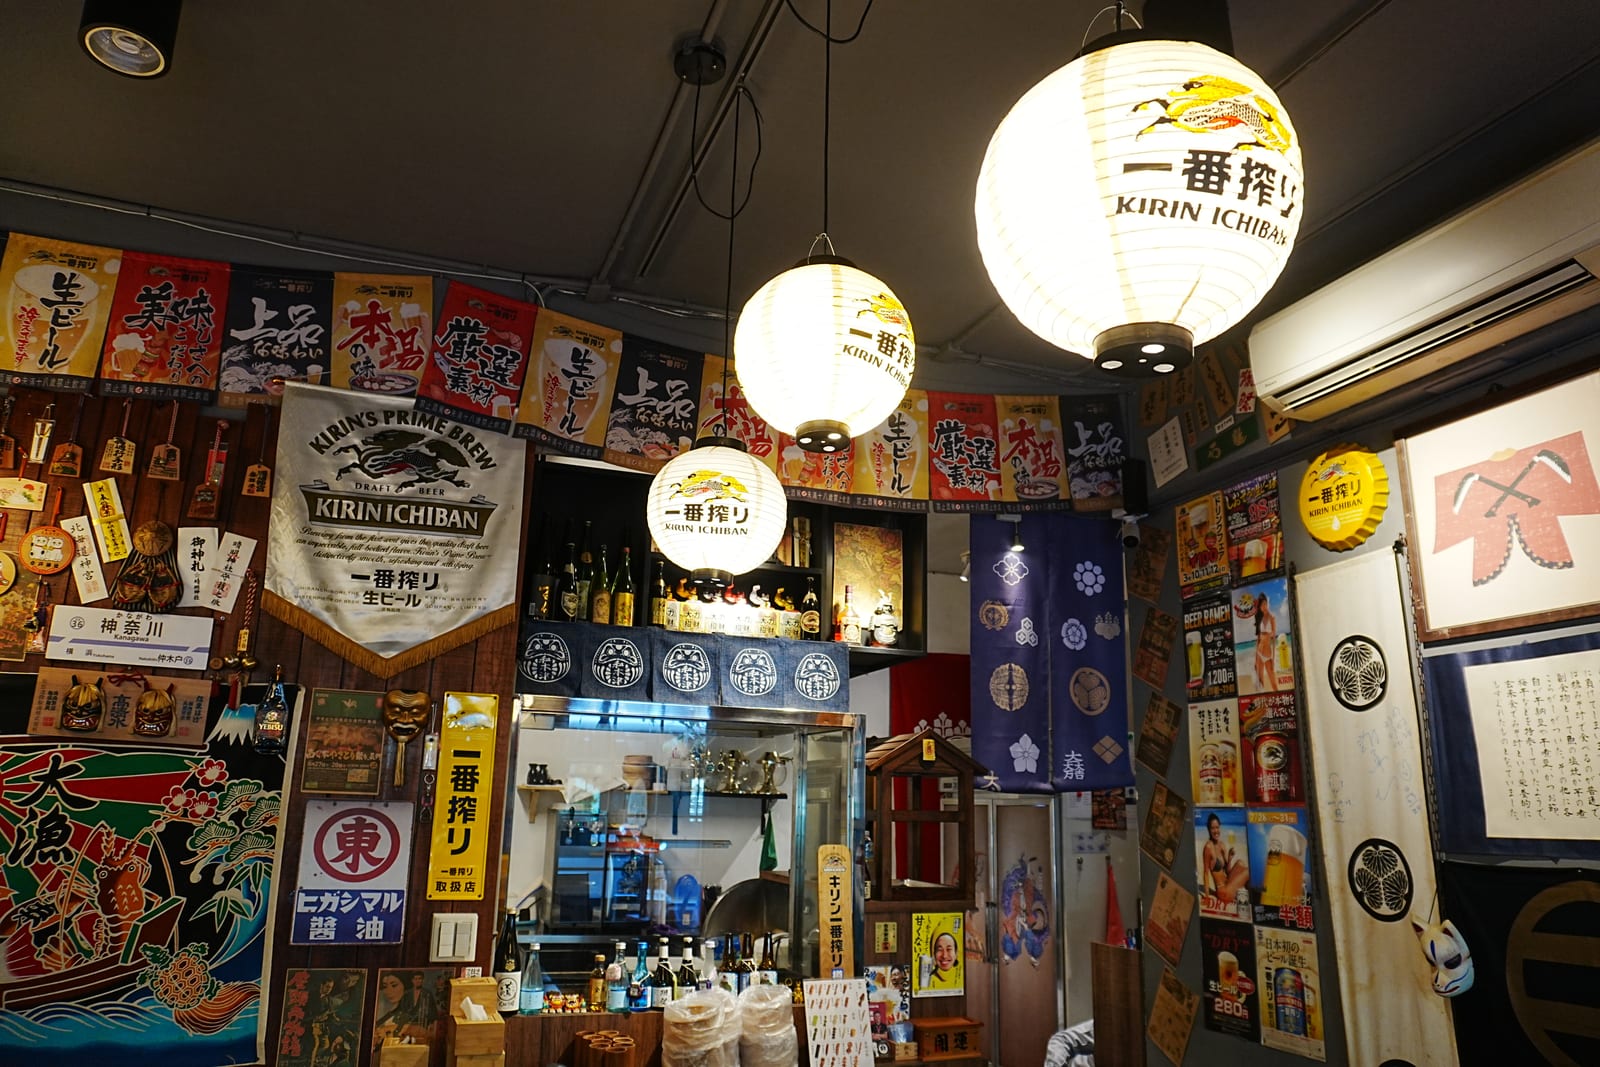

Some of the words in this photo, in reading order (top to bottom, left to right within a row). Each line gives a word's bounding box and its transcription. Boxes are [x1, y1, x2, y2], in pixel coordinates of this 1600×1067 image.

[1123, 149, 1296, 218] 一番搾り
[1115, 196, 1202, 221] KIRIN
[39, 272, 84, 368] 生ビール
[230, 297, 324, 348] 上品
[337, 300, 426, 370] 本場
[253, 340, 323, 359] な味わい
[349, 343, 377, 378] の味
[843, 344, 883, 368] KIRIN
[447, 367, 494, 407] 素材
[559, 347, 595, 436] 生ビール
[618, 366, 696, 420] 上品
[635, 406, 693, 431] な味わい
[308, 410, 378, 456] KIRIN'S
[383, 410, 448, 434] PRIME
[448, 424, 498, 471] BREW
[1002, 418, 1062, 478] 本場
[1069, 421, 1121, 459] 上品
[883, 412, 911, 495] 生ビール
[948, 463, 986, 493] 素材
[1011, 456, 1031, 486] の味
[355, 482, 391, 493] DRAFT
[419, 487, 445, 496] BEER
[1308, 479, 1361, 504] 一番搾り
[315, 498, 382, 523] KIRIN
[386, 504, 479, 530] ICHIBAN
[665, 504, 749, 524] 一番搾り
[1309, 506, 1329, 518] KIRIN
[1331, 498, 1363, 512] ICHIBAN
[665, 522, 695, 534] KIRIN
[698, 523, 748, 535] ICHIBAN
[190, 536, 206, 572] 御神札
[351, 569, 439, 591] 一番搾り
[362, 591, 421, 608] 生ビール
[101, 617, 163, 638] 神奈川
[116, 612, 153, 620] かながわ
[1184, 610, 1203, 629] BEER
[1204, 603, 1231, 626] RAMEN
[114, 634, 149, 643] Kanagawa
[258, 723, 283, 731] YEBISU
[7, 755, 98, 866] 大漁
[447, 749, 481, 855] 一番搾り
[329, 816, 385, 873] 東
[441, 867, 473, 876] 一番搾り
[436, 880, 476, 893] 取扱店
[297, 890, 403, 914] ヒガシマル
[829, 875, 844, 968] キリン一番搾り
[1279, 903, 1314, 929] 半額
[1265, 938, 1299, 953] 日本初の
[1209, 980, 1238, 994] 生ビール
[1214, 998, 1249, 1019] 280円
